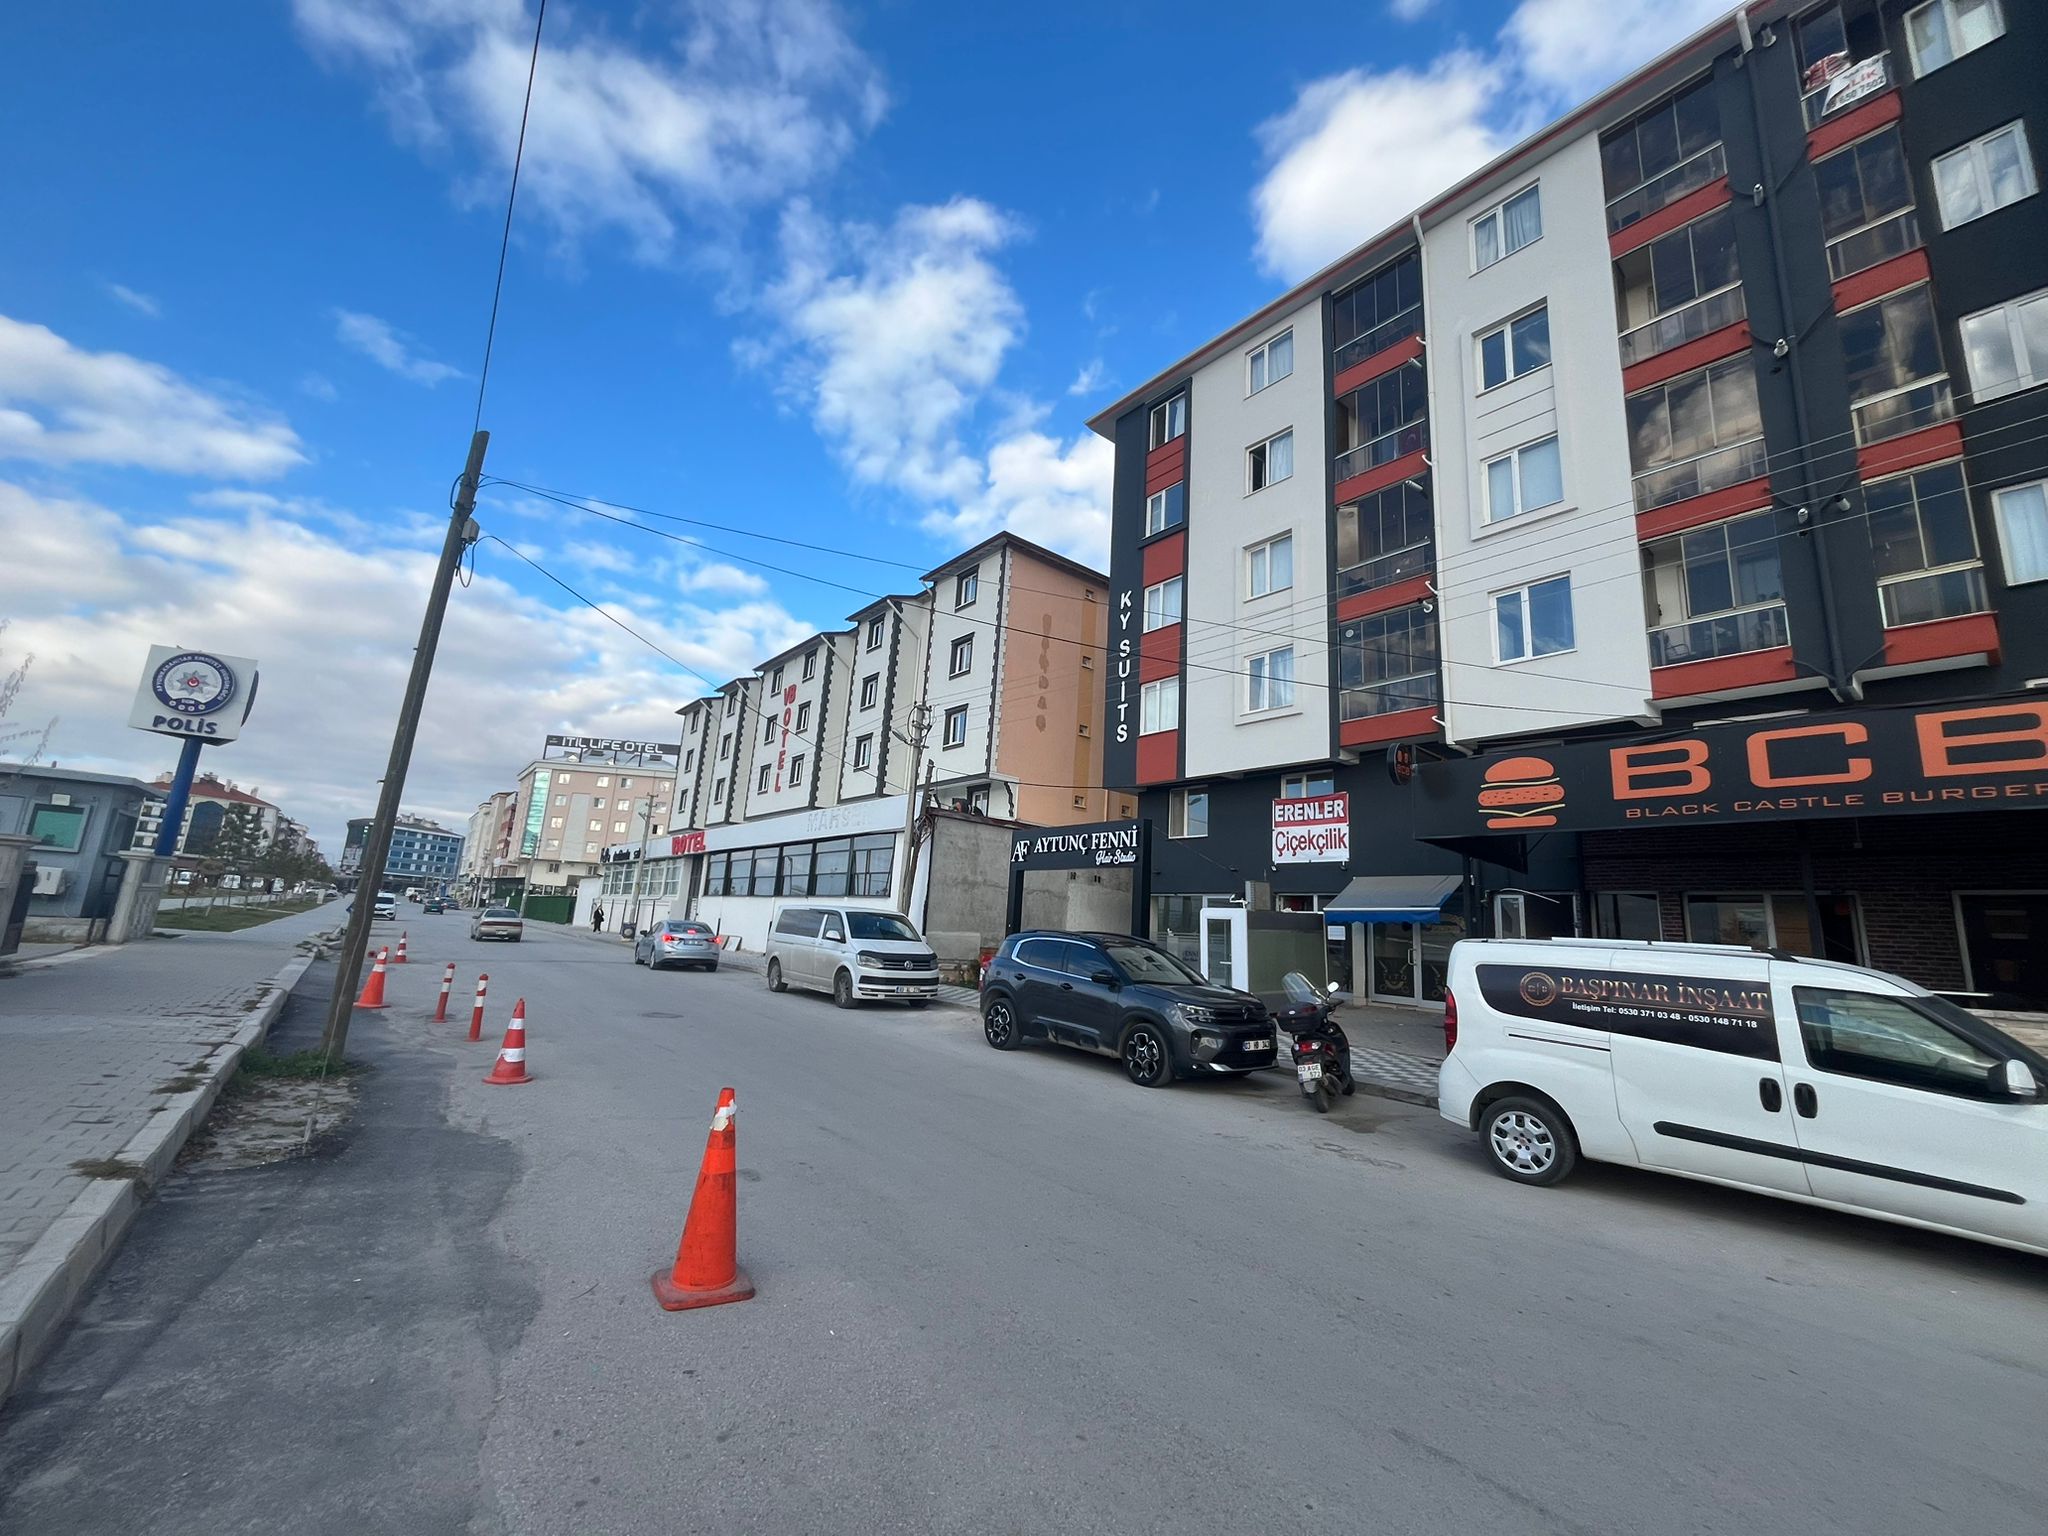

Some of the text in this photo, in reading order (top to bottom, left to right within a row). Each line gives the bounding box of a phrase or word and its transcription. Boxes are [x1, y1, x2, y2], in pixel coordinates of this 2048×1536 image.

[1120, 590, 1132, 630] KY
[152, 715, 218, 734] POLİS
[589, 738, 622, 751] LIFE
[624, 741, 664, 753] OTEL
[1609, 701, 2048, 800] BCB
[1275, 799, 1345, 822] ERENLER
[1625, 803, 1720, 818] BLACK
[1733, 794, 1865, 812] CASTLE
[1033, 833, 1089, 855] AYTUNÇ
[1091, 824, 1138, 849] FENNİ
[1275, 827, 1348, 857] Çiçekçilik
[1095, 849, 1113, 865] Hair
[1561, 976, 1768, 1011] BAŞPINAR İNŞAAT
[1602, 1006, 1617, 1014] Tel:
[1618, 1008, 1638, 1016] 0530
[1640, 1009, 1655, 1018] 371
[1657, 1011, 1668, 1019] 03
[1669, 1012, 1681, 1020] 48
[1688, 1014, 1710, 1023] 0530
[1712, 1016, 1729, 1025] 148
[1731, 1018, 1742, 1026] 71
[1745, 1020, 1757, 1028] 18
